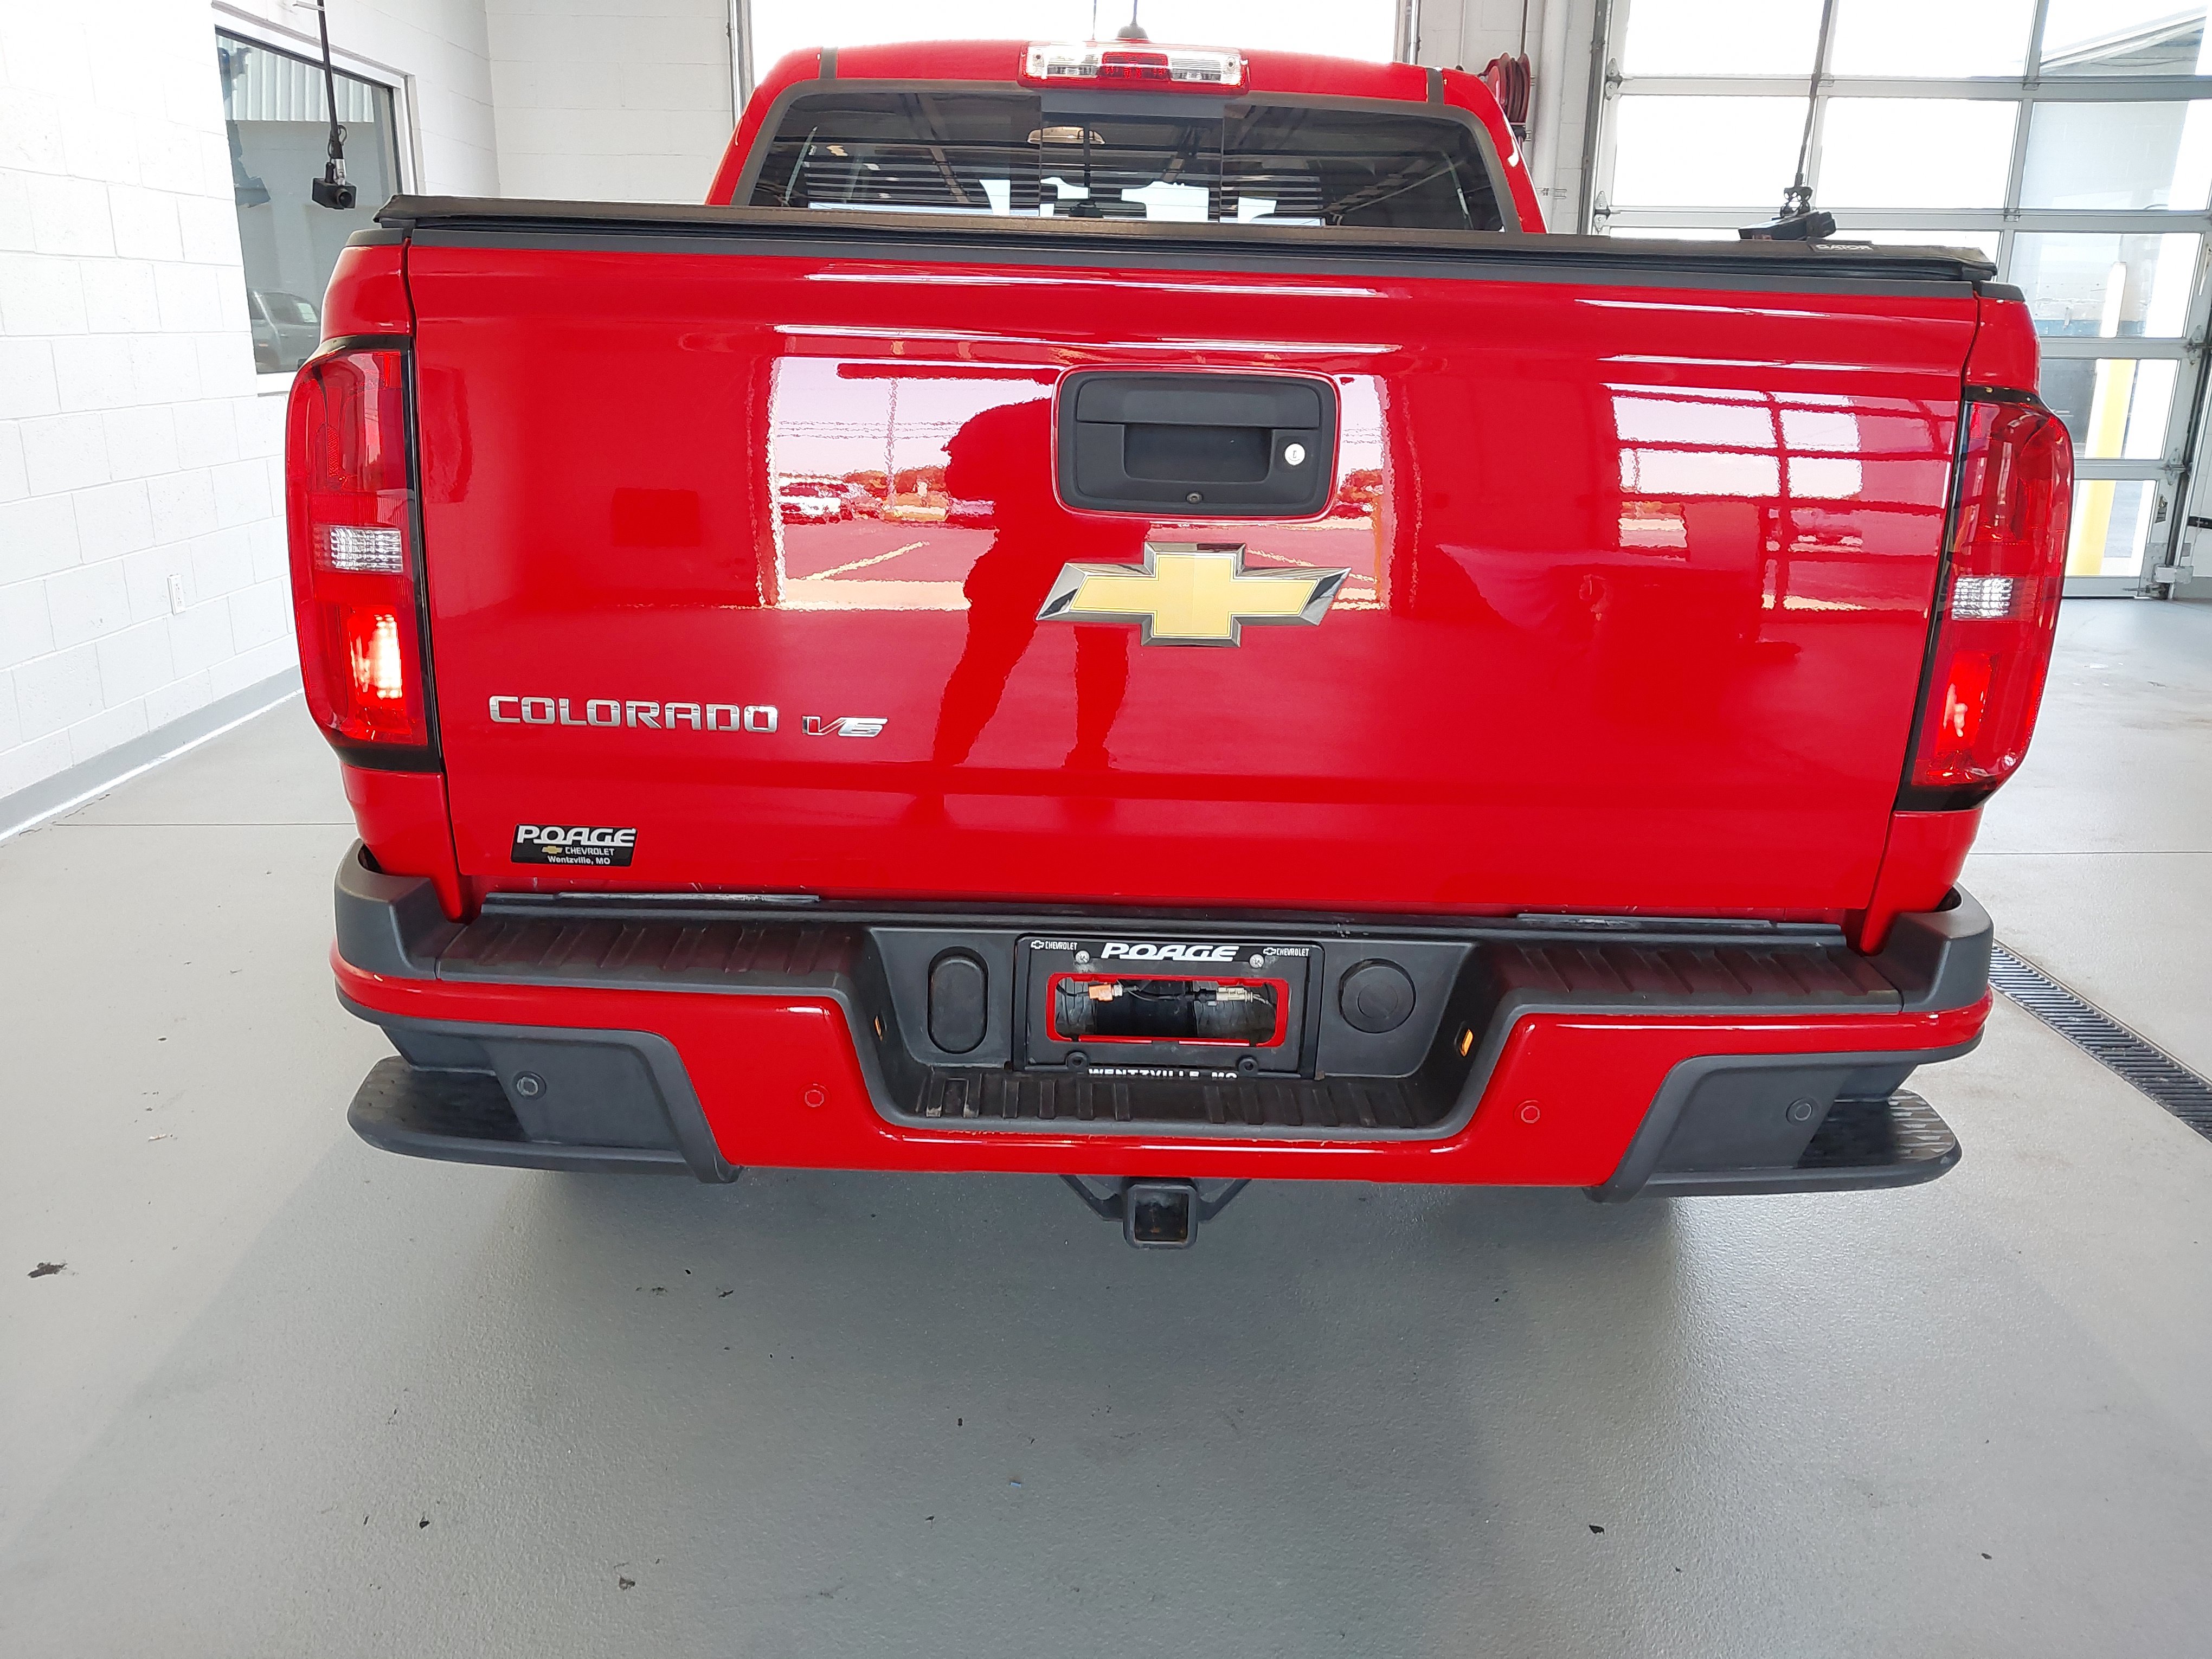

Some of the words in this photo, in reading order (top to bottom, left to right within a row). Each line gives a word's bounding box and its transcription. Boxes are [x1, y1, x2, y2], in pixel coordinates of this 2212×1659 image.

[489, 696, 779, 733] COLORADO
[802, 715, 889, 737] V6
[517, 825, 636, 847] POAGE
[565, 846, 615, 856] CHEVROLET
[547, 855, 594, 865] Wentzville,
[595, 857, 611, 865] MO
[1045, 941, 1078, 950] CHEVROLET
[1101, 942, 1239, 962] POAGE
[1276, 948, 1310, 957] CHEVROLET
